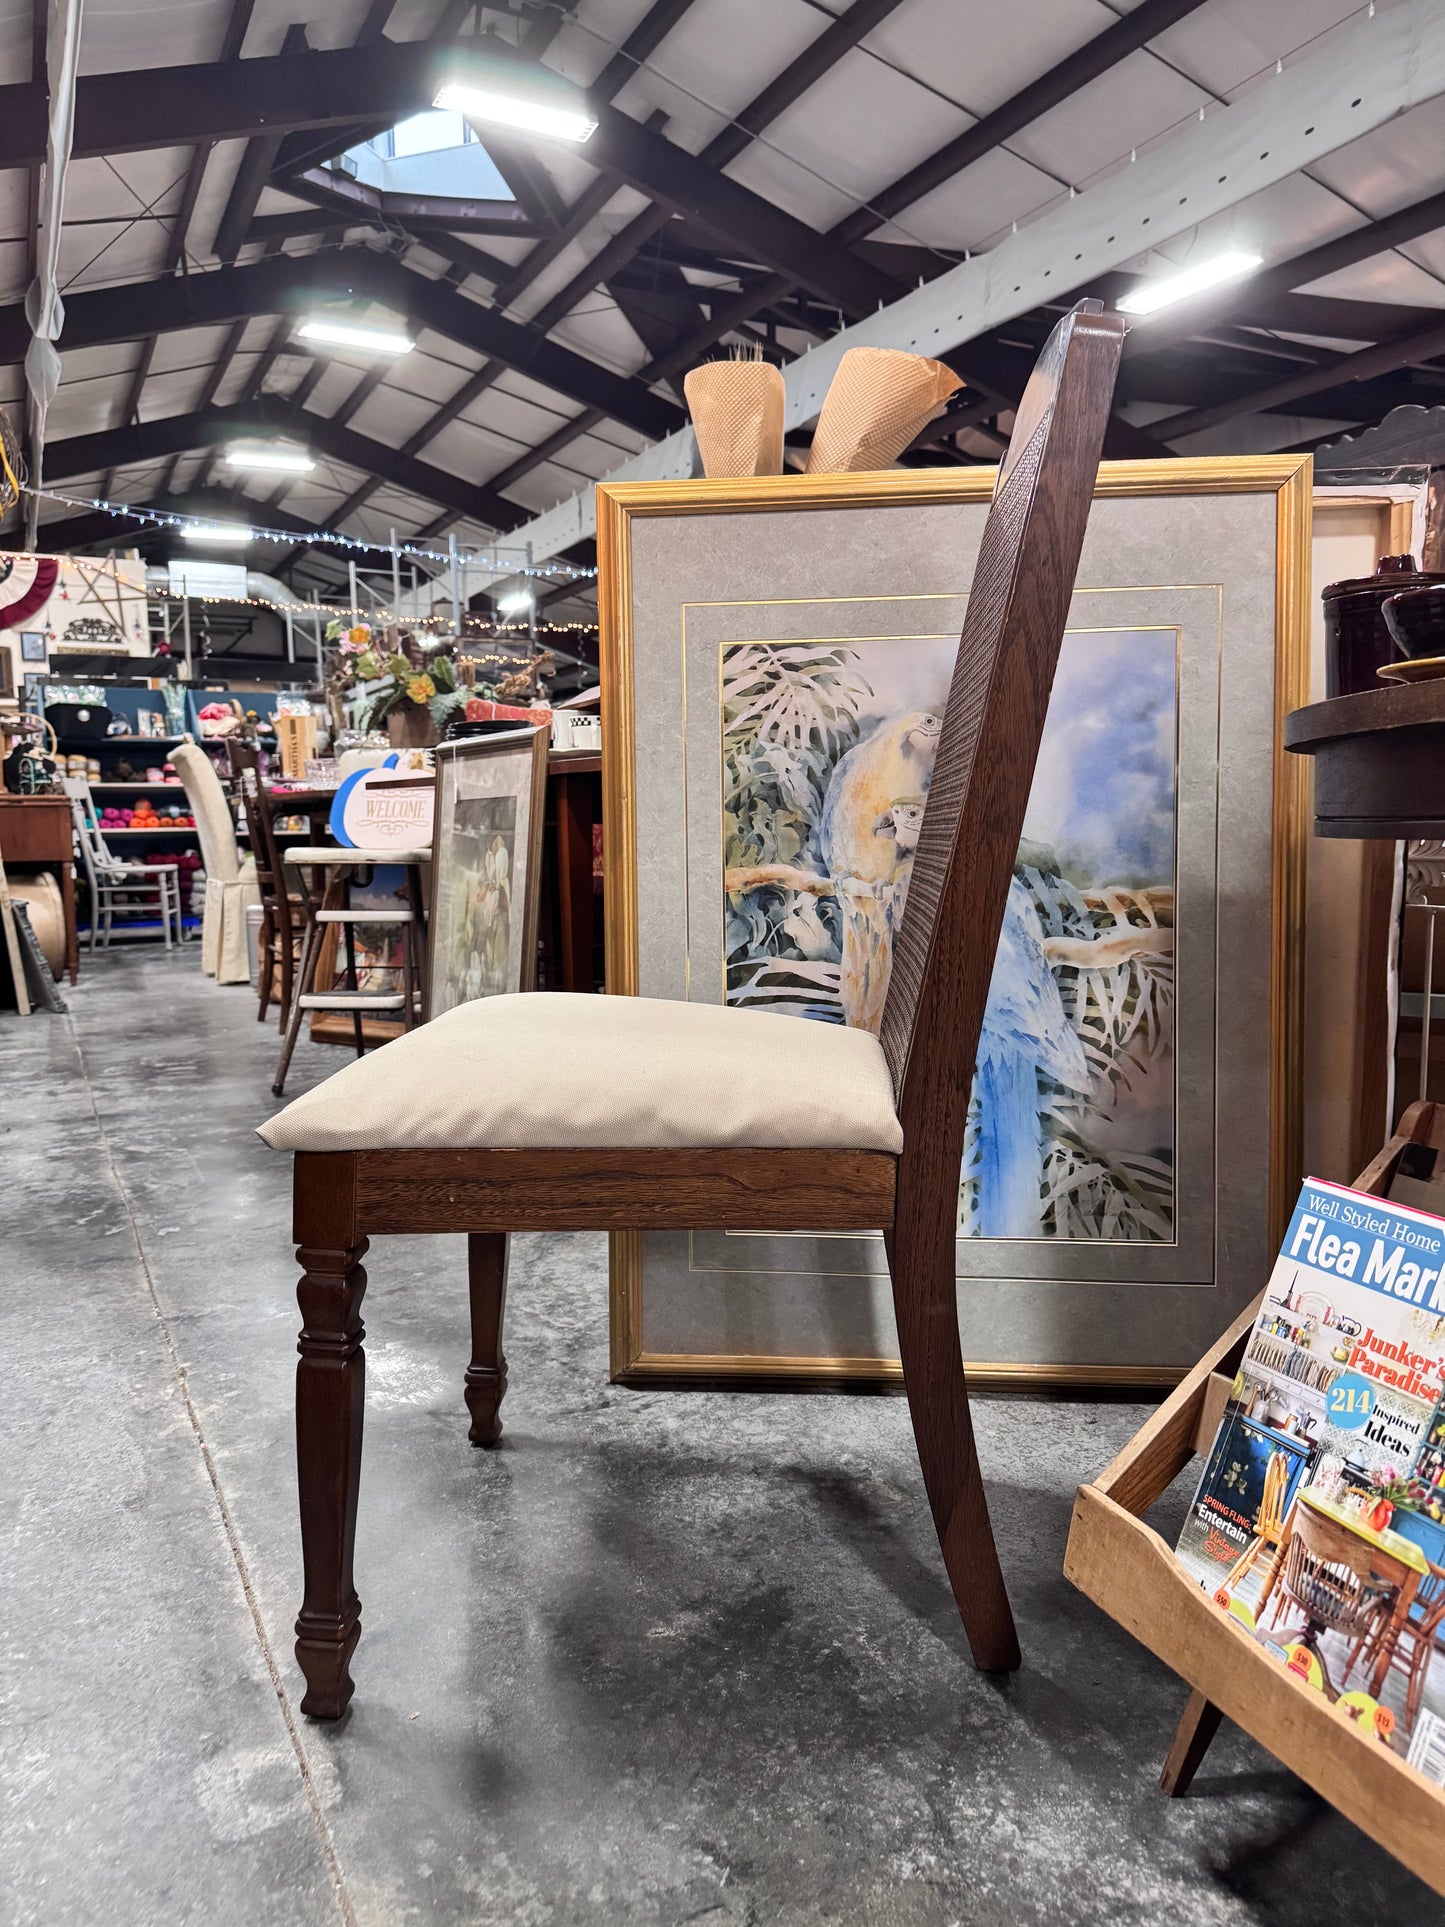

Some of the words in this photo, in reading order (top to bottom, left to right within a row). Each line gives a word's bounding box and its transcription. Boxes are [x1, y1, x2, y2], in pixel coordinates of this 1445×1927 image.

[366, 799, 427, 819] WELCOME
[1309, 1194, 1340, 1218] Well
[1341, 1206, 1390, 1235] Styled
[1392, 1223, 1441, 1252] Home
[1289, 1213, 1361, 1278] Flea
[1357, 1327, 1445, 1381] Junker's
[1348, 1345, 1442, 1405] Paradise
[1330, 1387, 1372, 1414] 214
[1372, 1404, 1420, 1435] Inspired
[1364, 1420, 1412, 1457] Ideas
[1198, 1503, 1247, 1545] Entertain
[1203, 1494, 1230, 1516] SPRING
[1228, 1510, 1252, 1530] FLING:
[1194, 1518, 1209, 1532] with
[1209, 1526, 1240, 1558] Vintage
